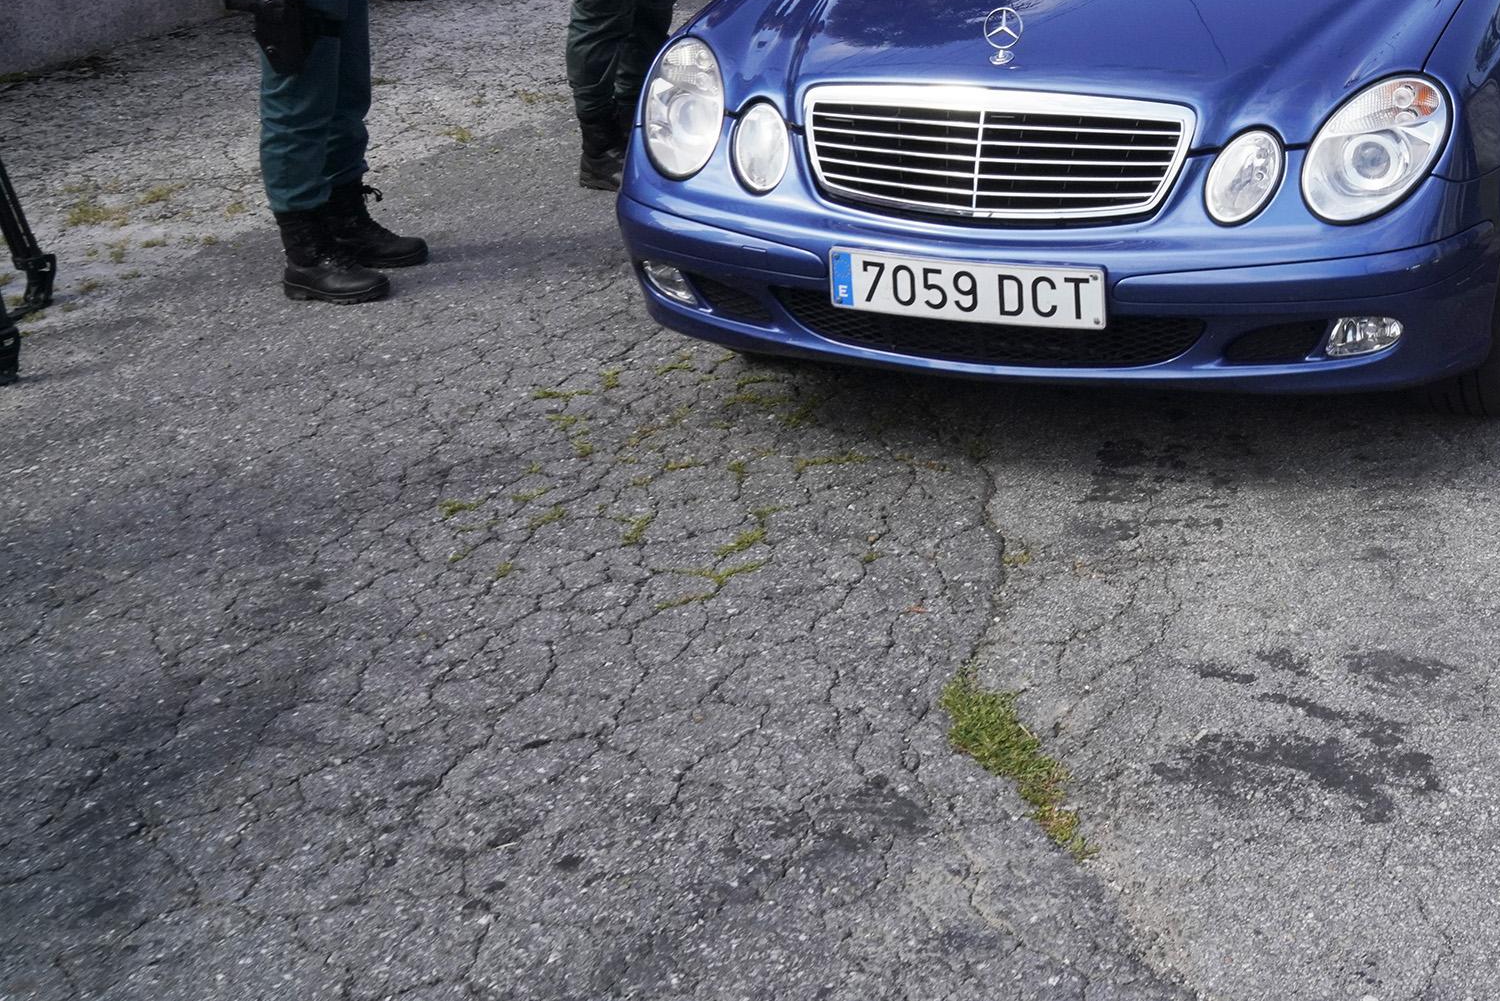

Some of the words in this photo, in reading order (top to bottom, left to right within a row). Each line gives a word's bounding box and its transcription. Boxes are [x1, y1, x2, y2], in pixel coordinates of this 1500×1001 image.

[838, 284, 849, 298] E
[862, 260, 979, 313] 7059
[998, 274, 1090, 320] DCT
